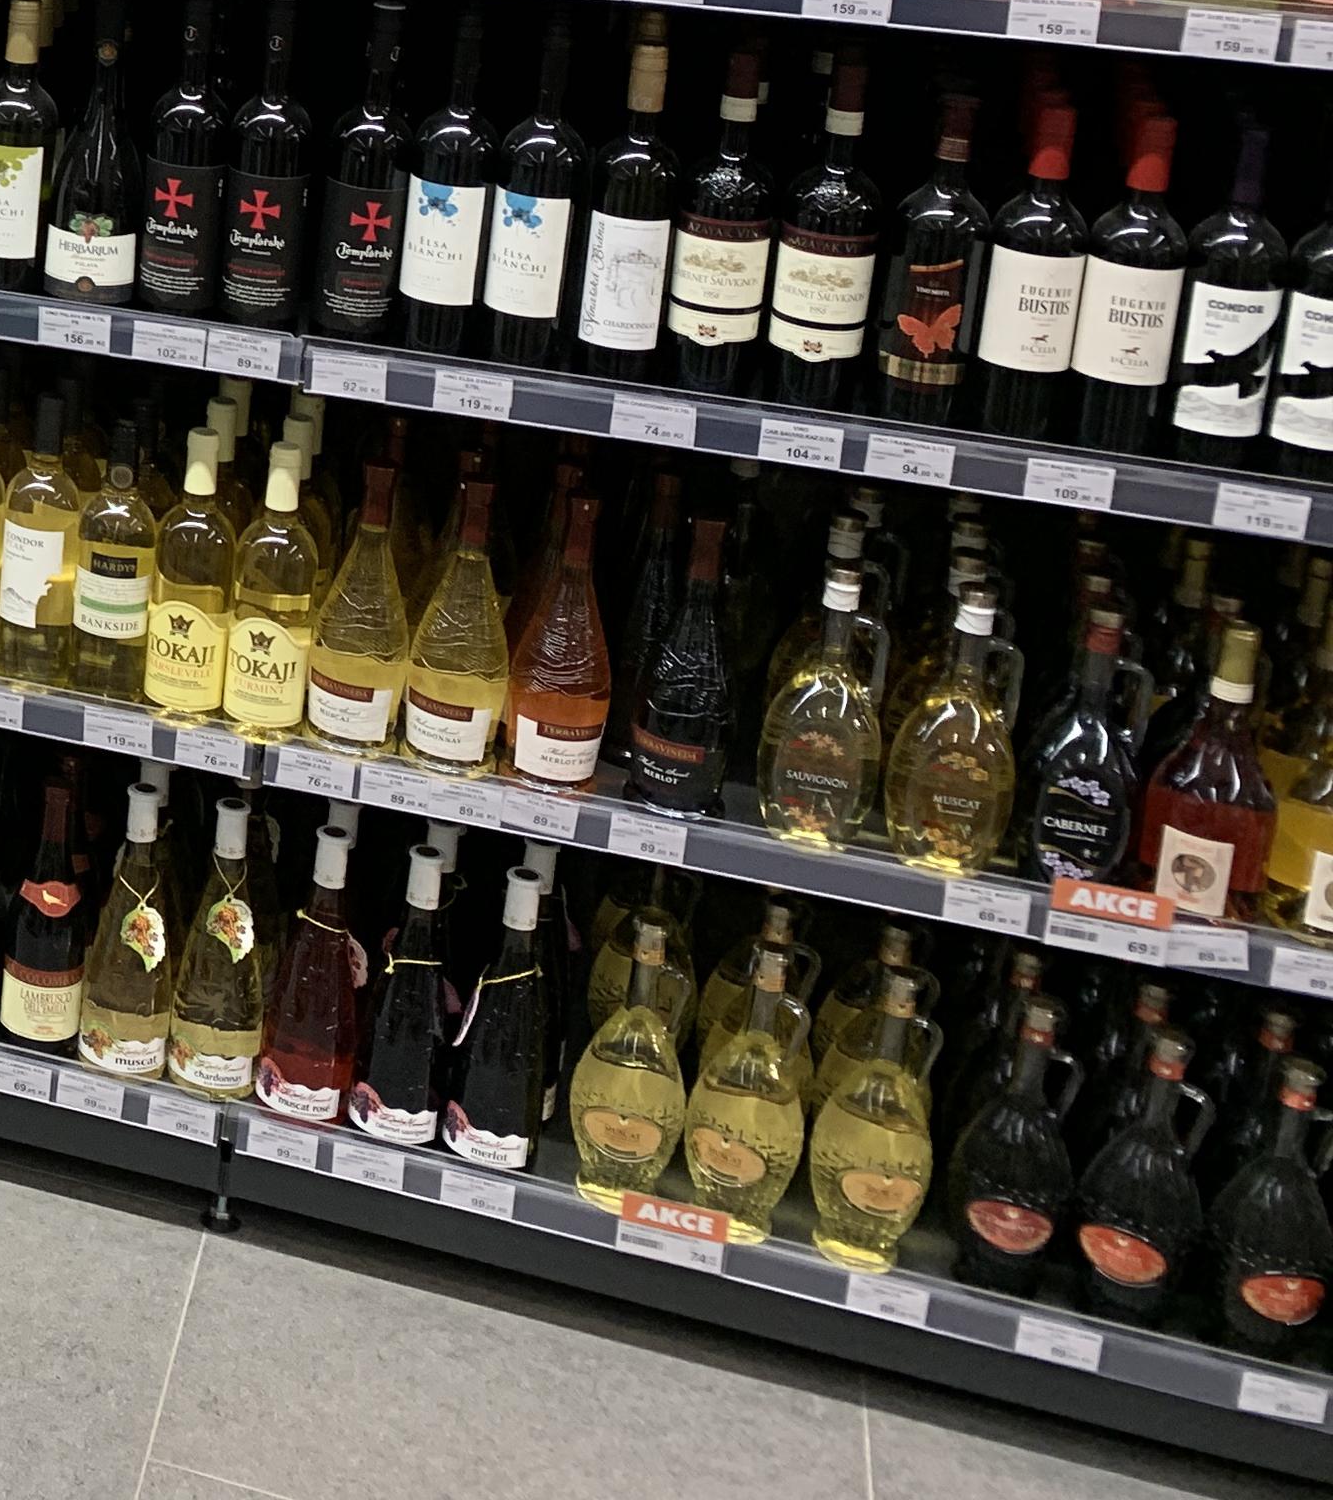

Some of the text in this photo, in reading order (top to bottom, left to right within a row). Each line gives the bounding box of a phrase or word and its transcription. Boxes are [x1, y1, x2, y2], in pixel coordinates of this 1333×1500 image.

[59, 240, 119, 257] HERBARIUM
[419, 235, 448, 249] ELSA
[408, 242, 463, 261] BIANCHI
[503, 247, 532, 262] ELSA
[491, 254, 547, 274] BIANCHI
[1021, 283, 1073, 299] EUGENIO
[1018, 298, 1070, 316] BUSTOS
[1111, 295, 1166, 311] EUGENIO
[1108, 308, 1164, 329] BUSTOS
[80, 614, 140, 632] BANKSIDE
[149, 633, 217, 668] TOKAJI
[230, 647, 297, 684] TOKAJI
[643, 769, 678, 785] MERLOT
[785, 769, 849, 790] SAUVIGNON
[933, 794, 981, 810] MUSCAT
[1043, 815, 1108, 837] CABERNET
[1070, 887, 1158, 920] AKCE
[20, 988, 73, 1004] LAMBRUSCO
[114, 1053, 158, 1067] muscat
[193, 1068, 243, 1085] chardonnay
[278, 1094, 310, 1114] muscat
[470, 1146, 509, 1162] merlot
[637, 1202, 715, 1233] AKCE
